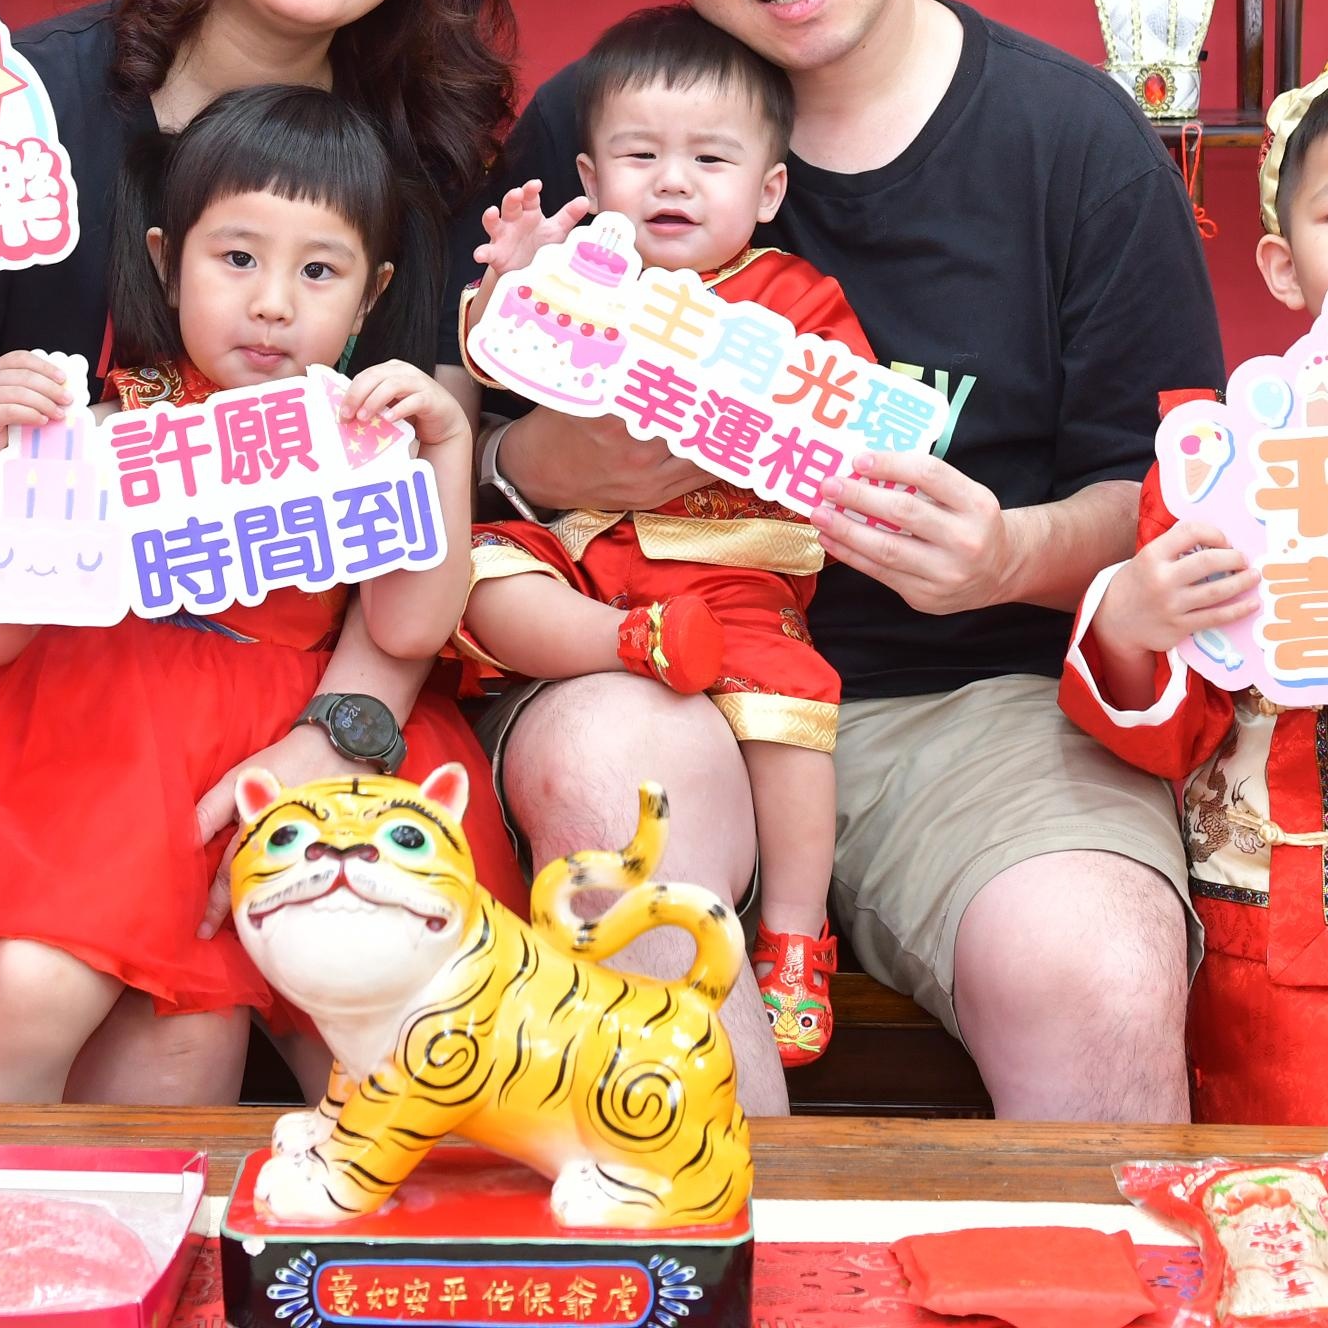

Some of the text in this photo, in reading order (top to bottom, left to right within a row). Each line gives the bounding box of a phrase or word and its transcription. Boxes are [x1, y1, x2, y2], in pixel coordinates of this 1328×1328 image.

[614, 358, 918, 532] 幸運相
[629, 282, 936, 453] 主角光環
[109, 386, 320, 508] 許願
[131, 470, 440, 609] 時間到
